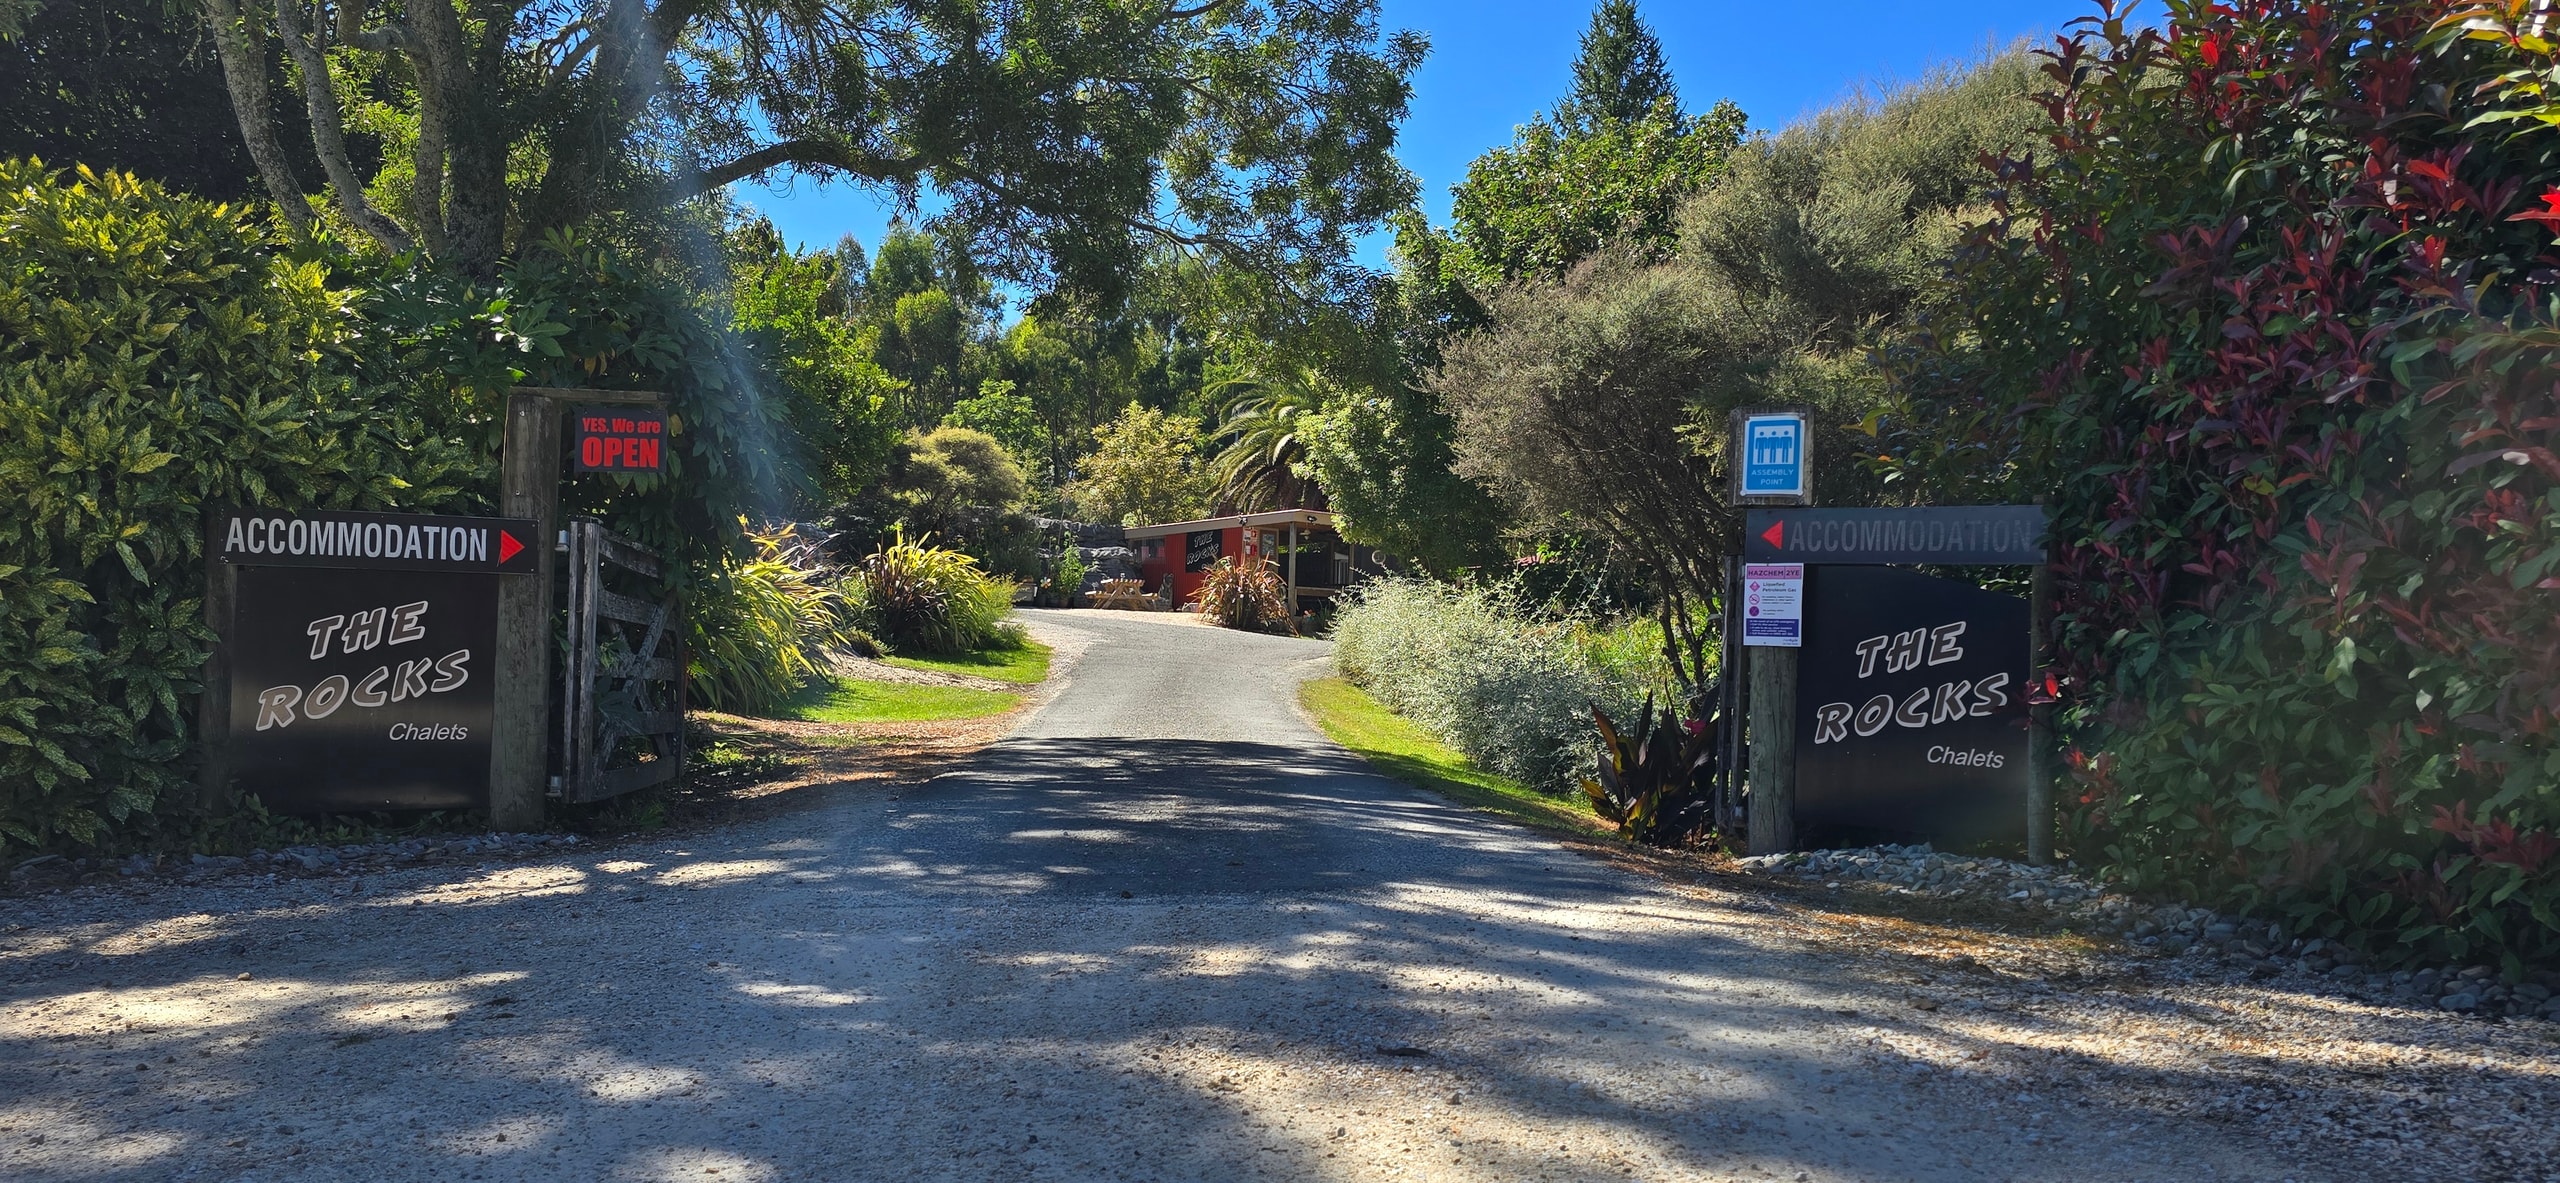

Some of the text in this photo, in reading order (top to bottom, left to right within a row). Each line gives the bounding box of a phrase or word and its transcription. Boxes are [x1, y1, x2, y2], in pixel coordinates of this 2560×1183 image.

[582, 417, 661, 434] YES, We are
[582, 436, 659, 468] OPEN
[1751, 468, 1794, 476] ASSEMBLY
[1760, 478, 1784, 486] POINT
[225, 517, 488, 562] ACCOMMODATION
[1789, 519, 2032, 553] ACCOMMODATION
[1748, 569, 1800, 577] HAZCHEM 2YE
[307, 600, 429, 660] THE
[1856, 621, 1967, 679] THE
[255, 648, 470, 732] ROCKS
[1814, 672, 2010, 745] ROCKS
[388, 722, 469, 741] Chalets
[1926, 745, 2005, 769] Chalets
